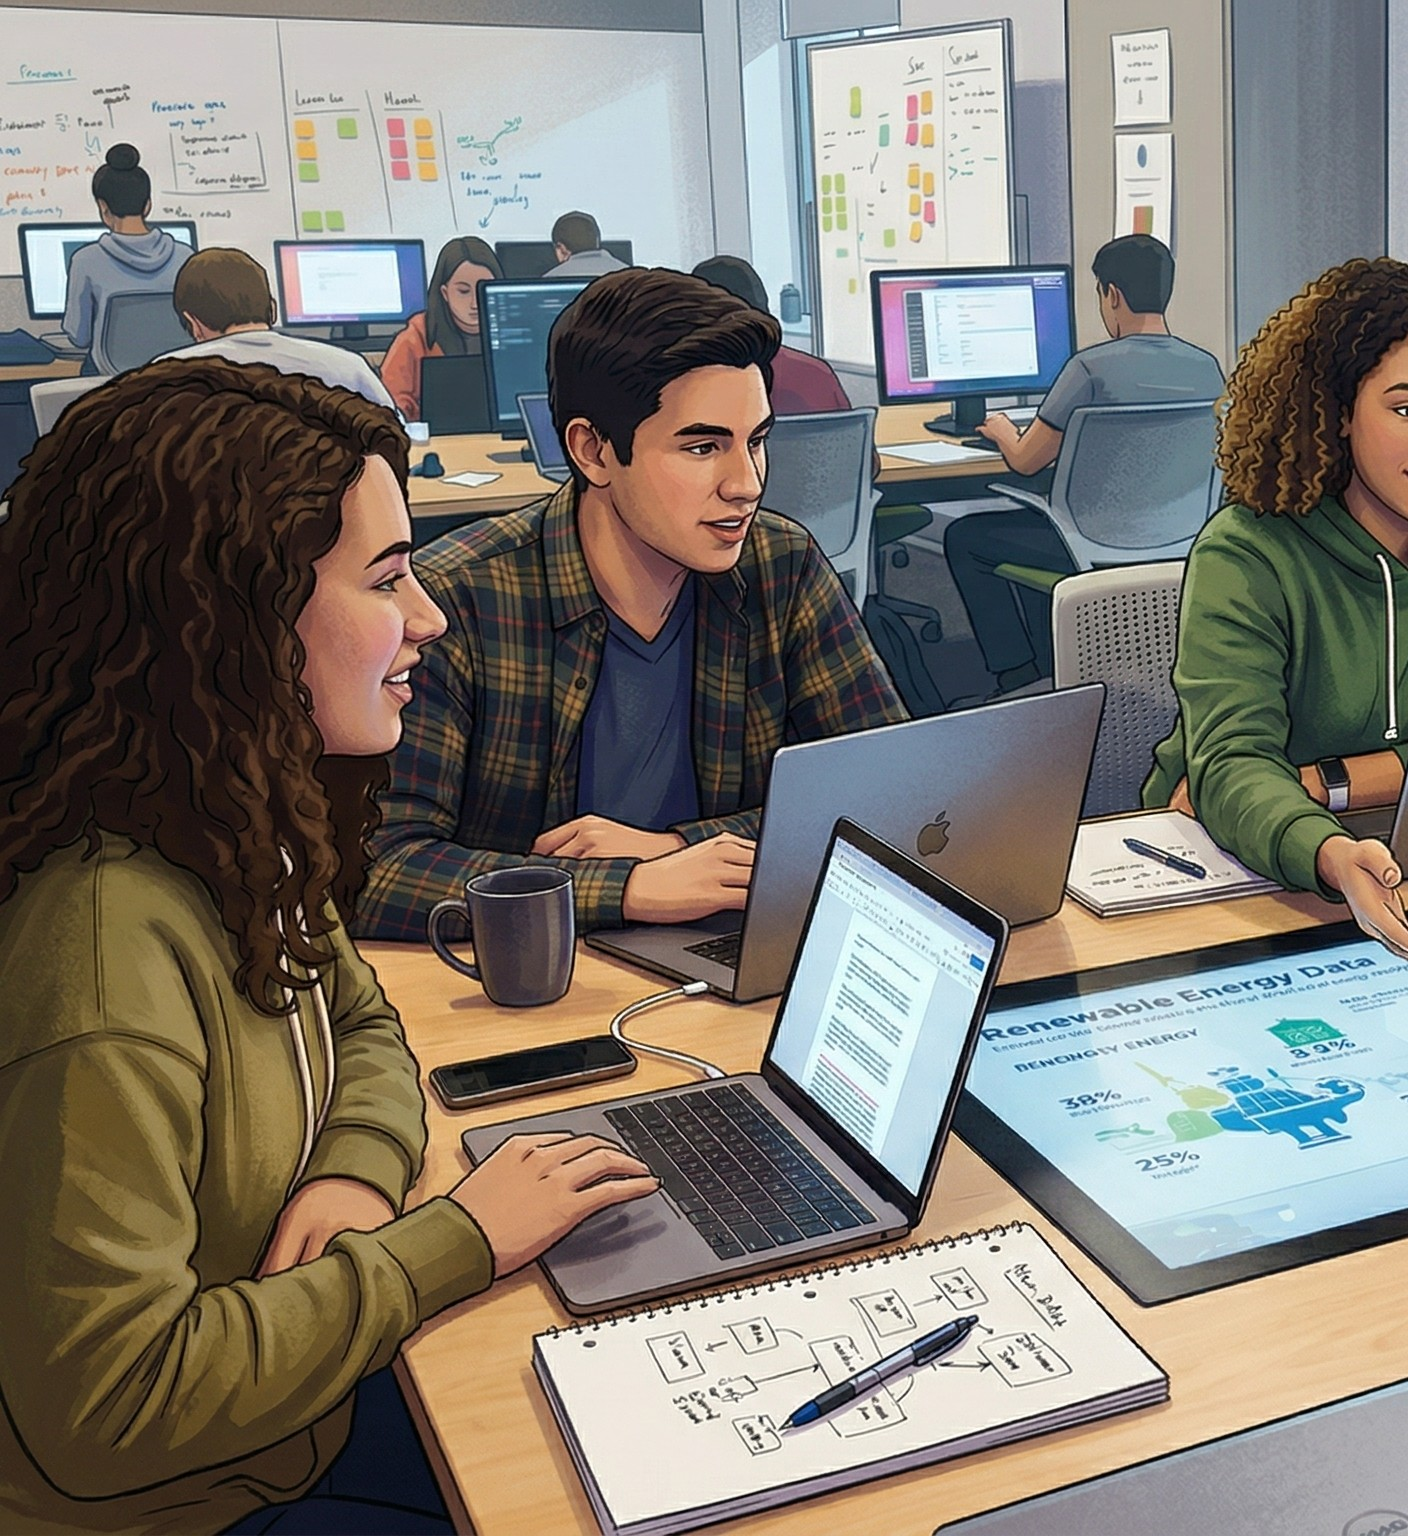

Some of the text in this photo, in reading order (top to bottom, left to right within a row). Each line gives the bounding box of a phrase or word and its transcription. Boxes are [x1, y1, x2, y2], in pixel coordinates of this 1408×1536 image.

[981, 995, 1175, 1042] Renewable
[1177, 971, 1293, 1003] Energy
[1297, 957, 1377, 979] Data
[1125, 1028, 1199, 1050] ENERGY
[1059, 1089, 1122, 1110] 38%
[1135, 1150, 1200, 1172] 25%
